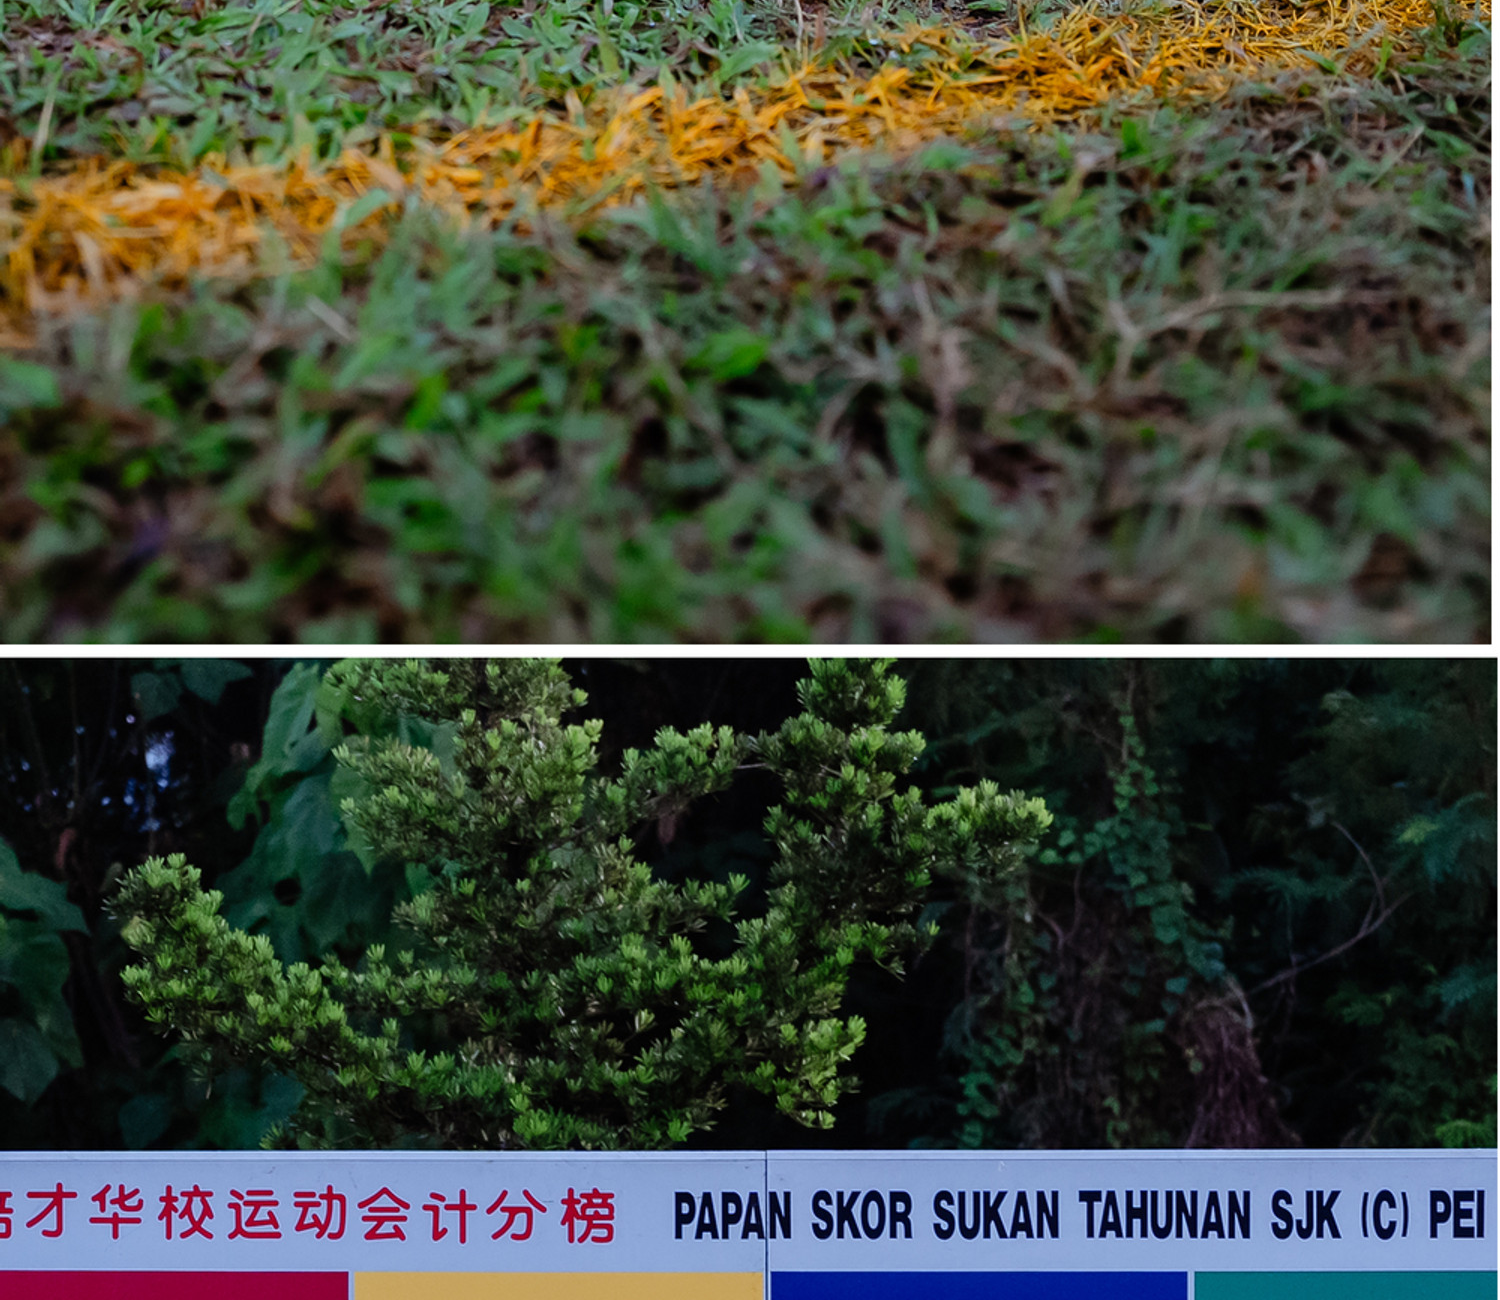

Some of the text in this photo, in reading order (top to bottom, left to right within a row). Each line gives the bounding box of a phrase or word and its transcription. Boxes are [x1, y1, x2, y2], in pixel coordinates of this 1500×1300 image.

[0, 1183, 614, 1244] 才华校运动会计分榜
[674, 1189, 1485, 1241] PAPAN SKOR SUKAN TAHUNAN SJK (C) PEI
